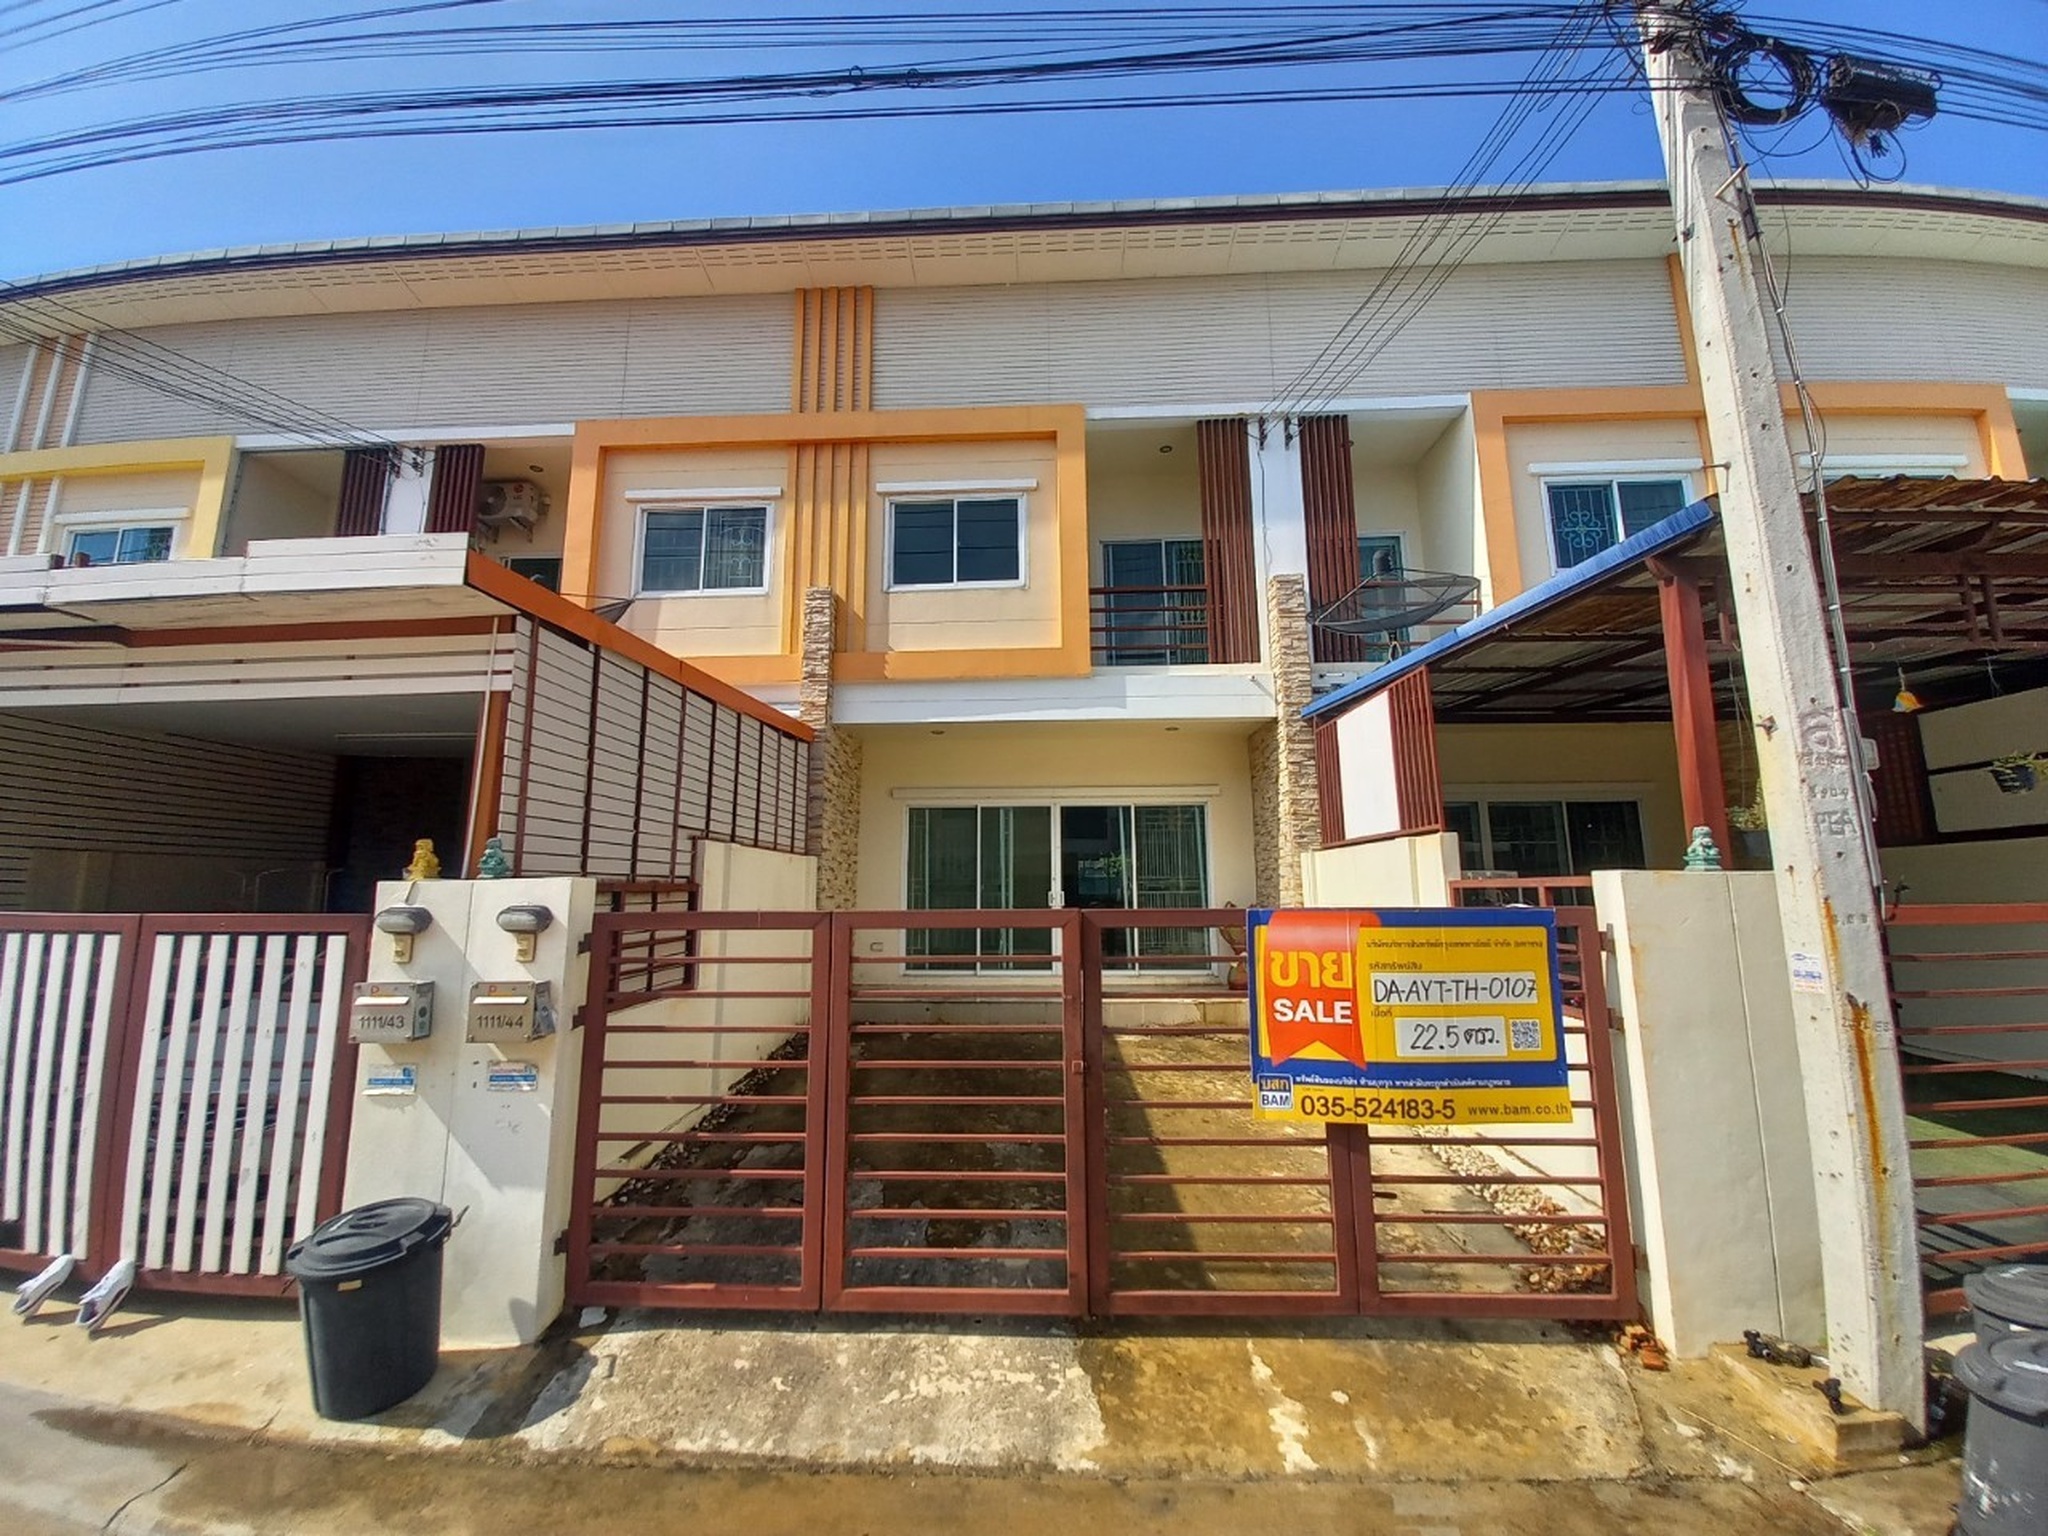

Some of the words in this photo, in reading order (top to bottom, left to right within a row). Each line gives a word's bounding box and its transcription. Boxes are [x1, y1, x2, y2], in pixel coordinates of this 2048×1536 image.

[1270, 949, 1353, 989] ขาย
[1373, 976, 1537, 1004] DA-AYT-TH-0107
[359, 1015, 406, 1030] 1111/43
[477, 1014, 524, 1030] 1111/44
[1273, 998, 1353, 1025] SALE
[1410, 1023, 1460, 1051] 22.5
[1261, 1093, 1290, 1107] BAM
[1301, 1095, 1456, 1120] 035-524183-5
[1467, 1102, 1569, 1116] www.bam.co.th
